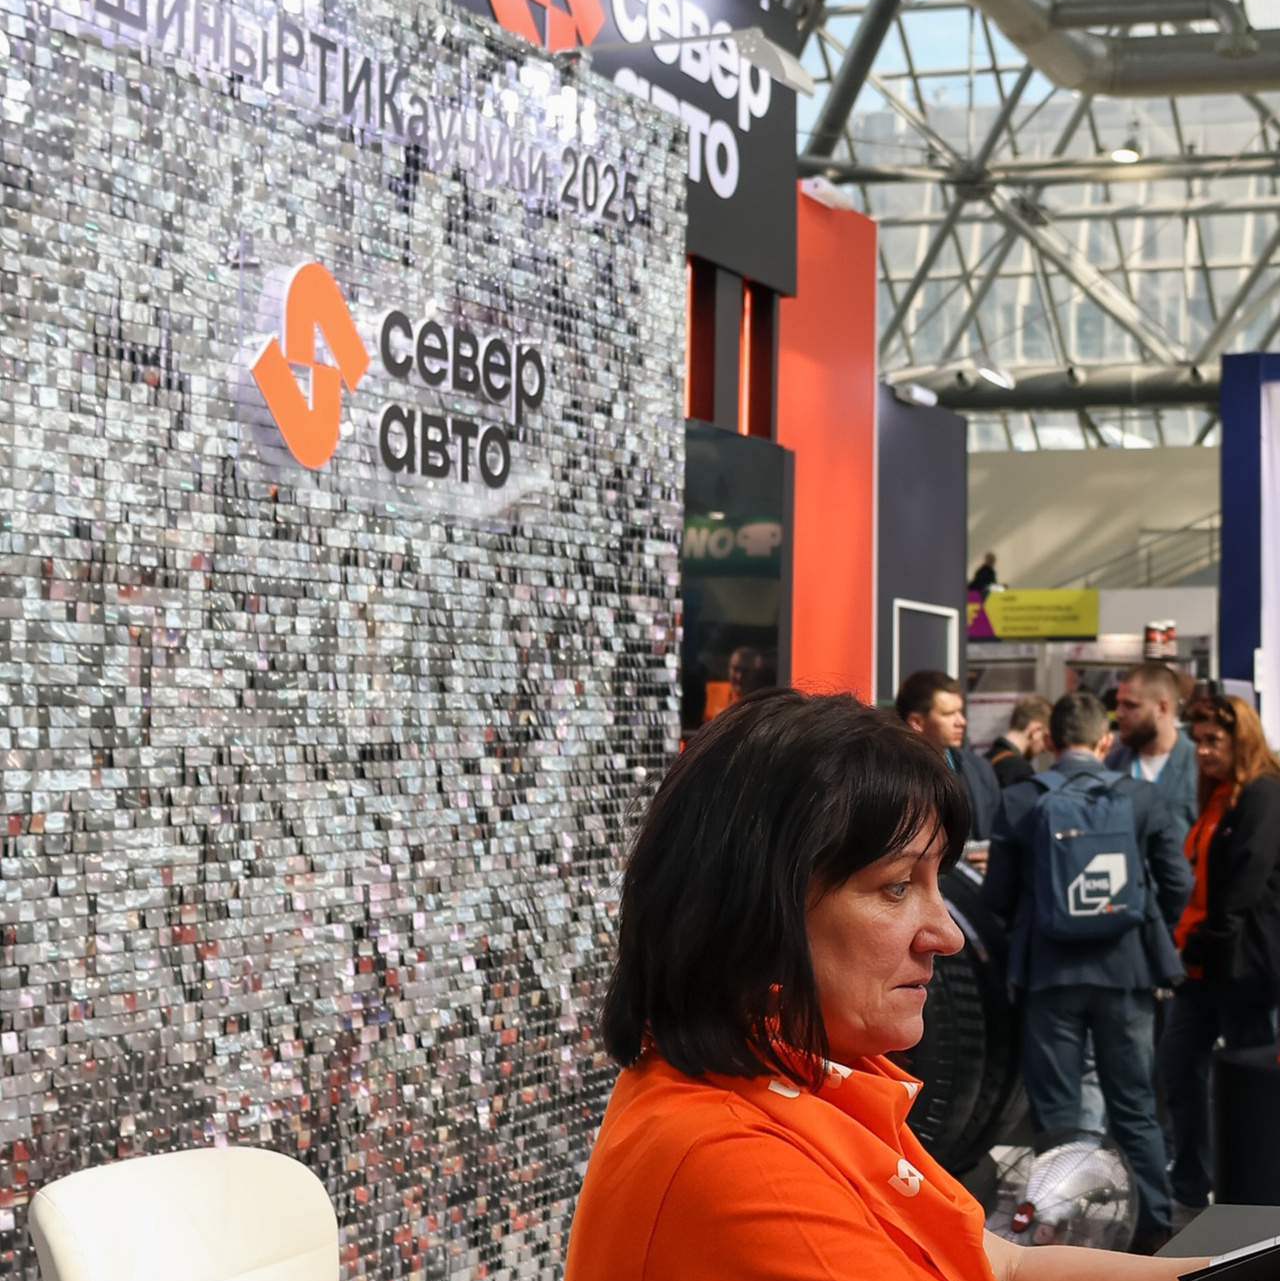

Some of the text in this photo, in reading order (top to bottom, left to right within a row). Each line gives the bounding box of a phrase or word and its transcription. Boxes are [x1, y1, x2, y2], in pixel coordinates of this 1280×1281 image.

[561, 146, 638, 226] 2025
[380, 310, 545, 425] север
[380, 404, 511, 489] авто
